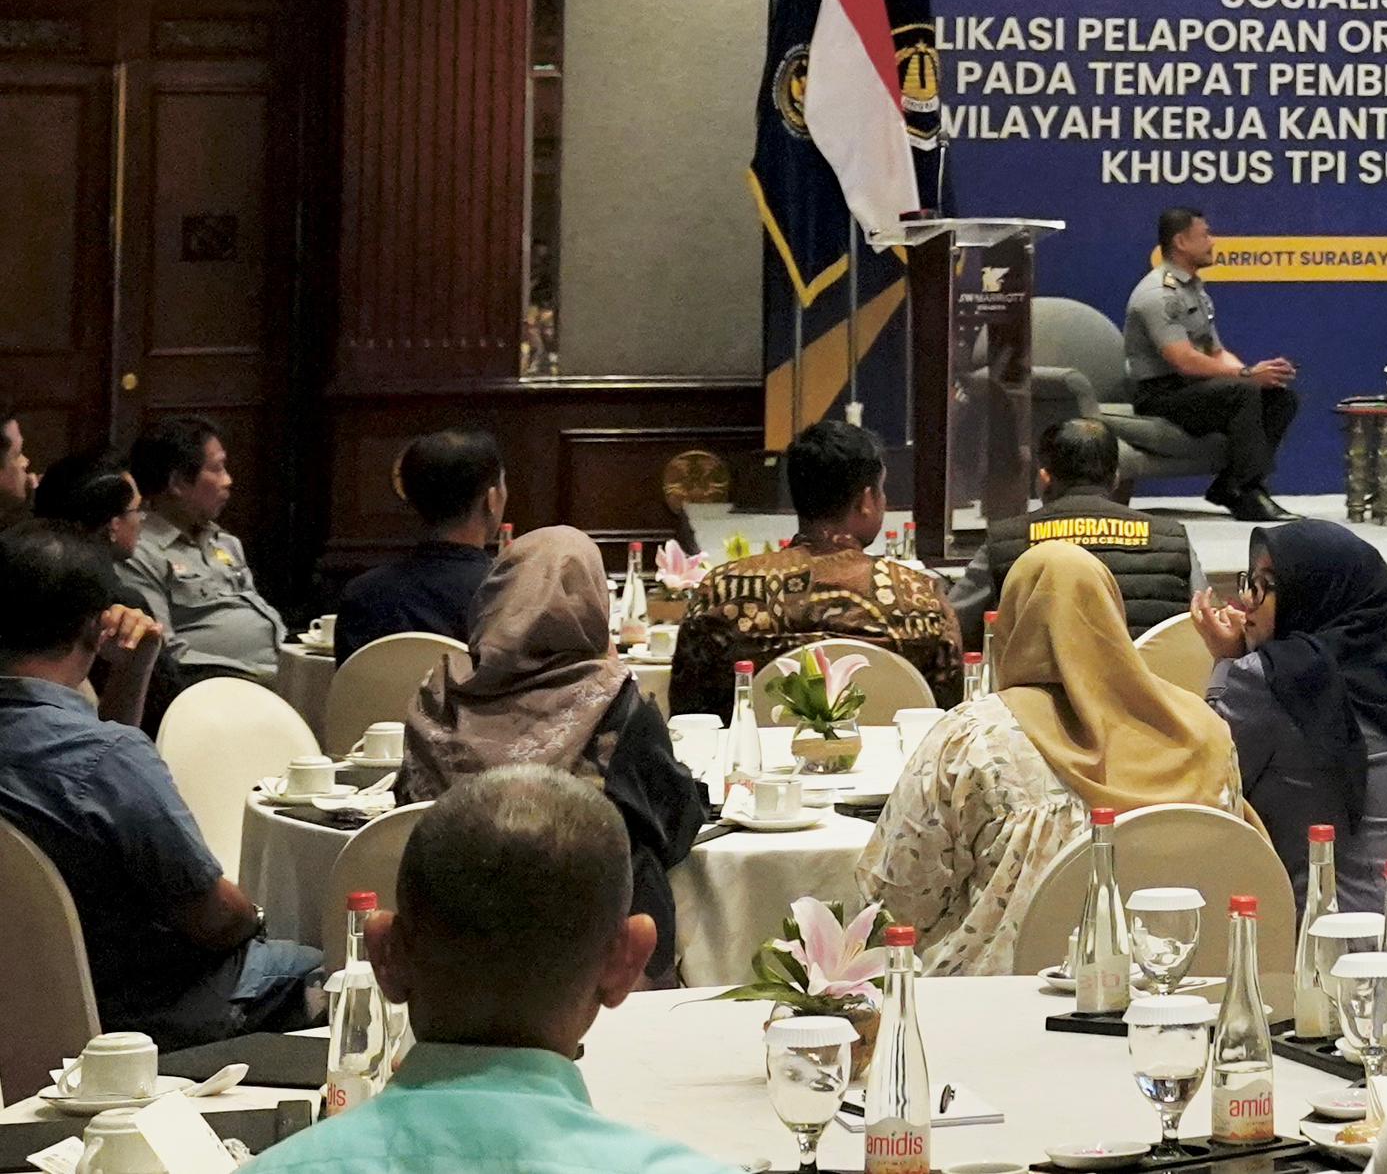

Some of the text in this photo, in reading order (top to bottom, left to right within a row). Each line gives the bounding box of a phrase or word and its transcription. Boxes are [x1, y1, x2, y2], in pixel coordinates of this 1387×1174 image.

[933, 16, 1067, 52] LIKASI
[1078, 17, 1327, 54] PELAPORAN
[957, 61, 1077, 95] PADA
[1087, 61, 1258, 96] TEMPAT
[1133, 105, 1267, 140] KERJA
[1102, 150, 1274, 184] KHUSUS
[1284, 150, 1347, 184] TPI
[1214, 251, 1296, 266] ARRIOTT
[1030, 518, 1149, 540] IMMIGRATION
[1066, 536, 1149, 546] FORCEMENT
[1229, 1091, 1272, 1118] amid
[866, 1130, 924, 1157] amidis
